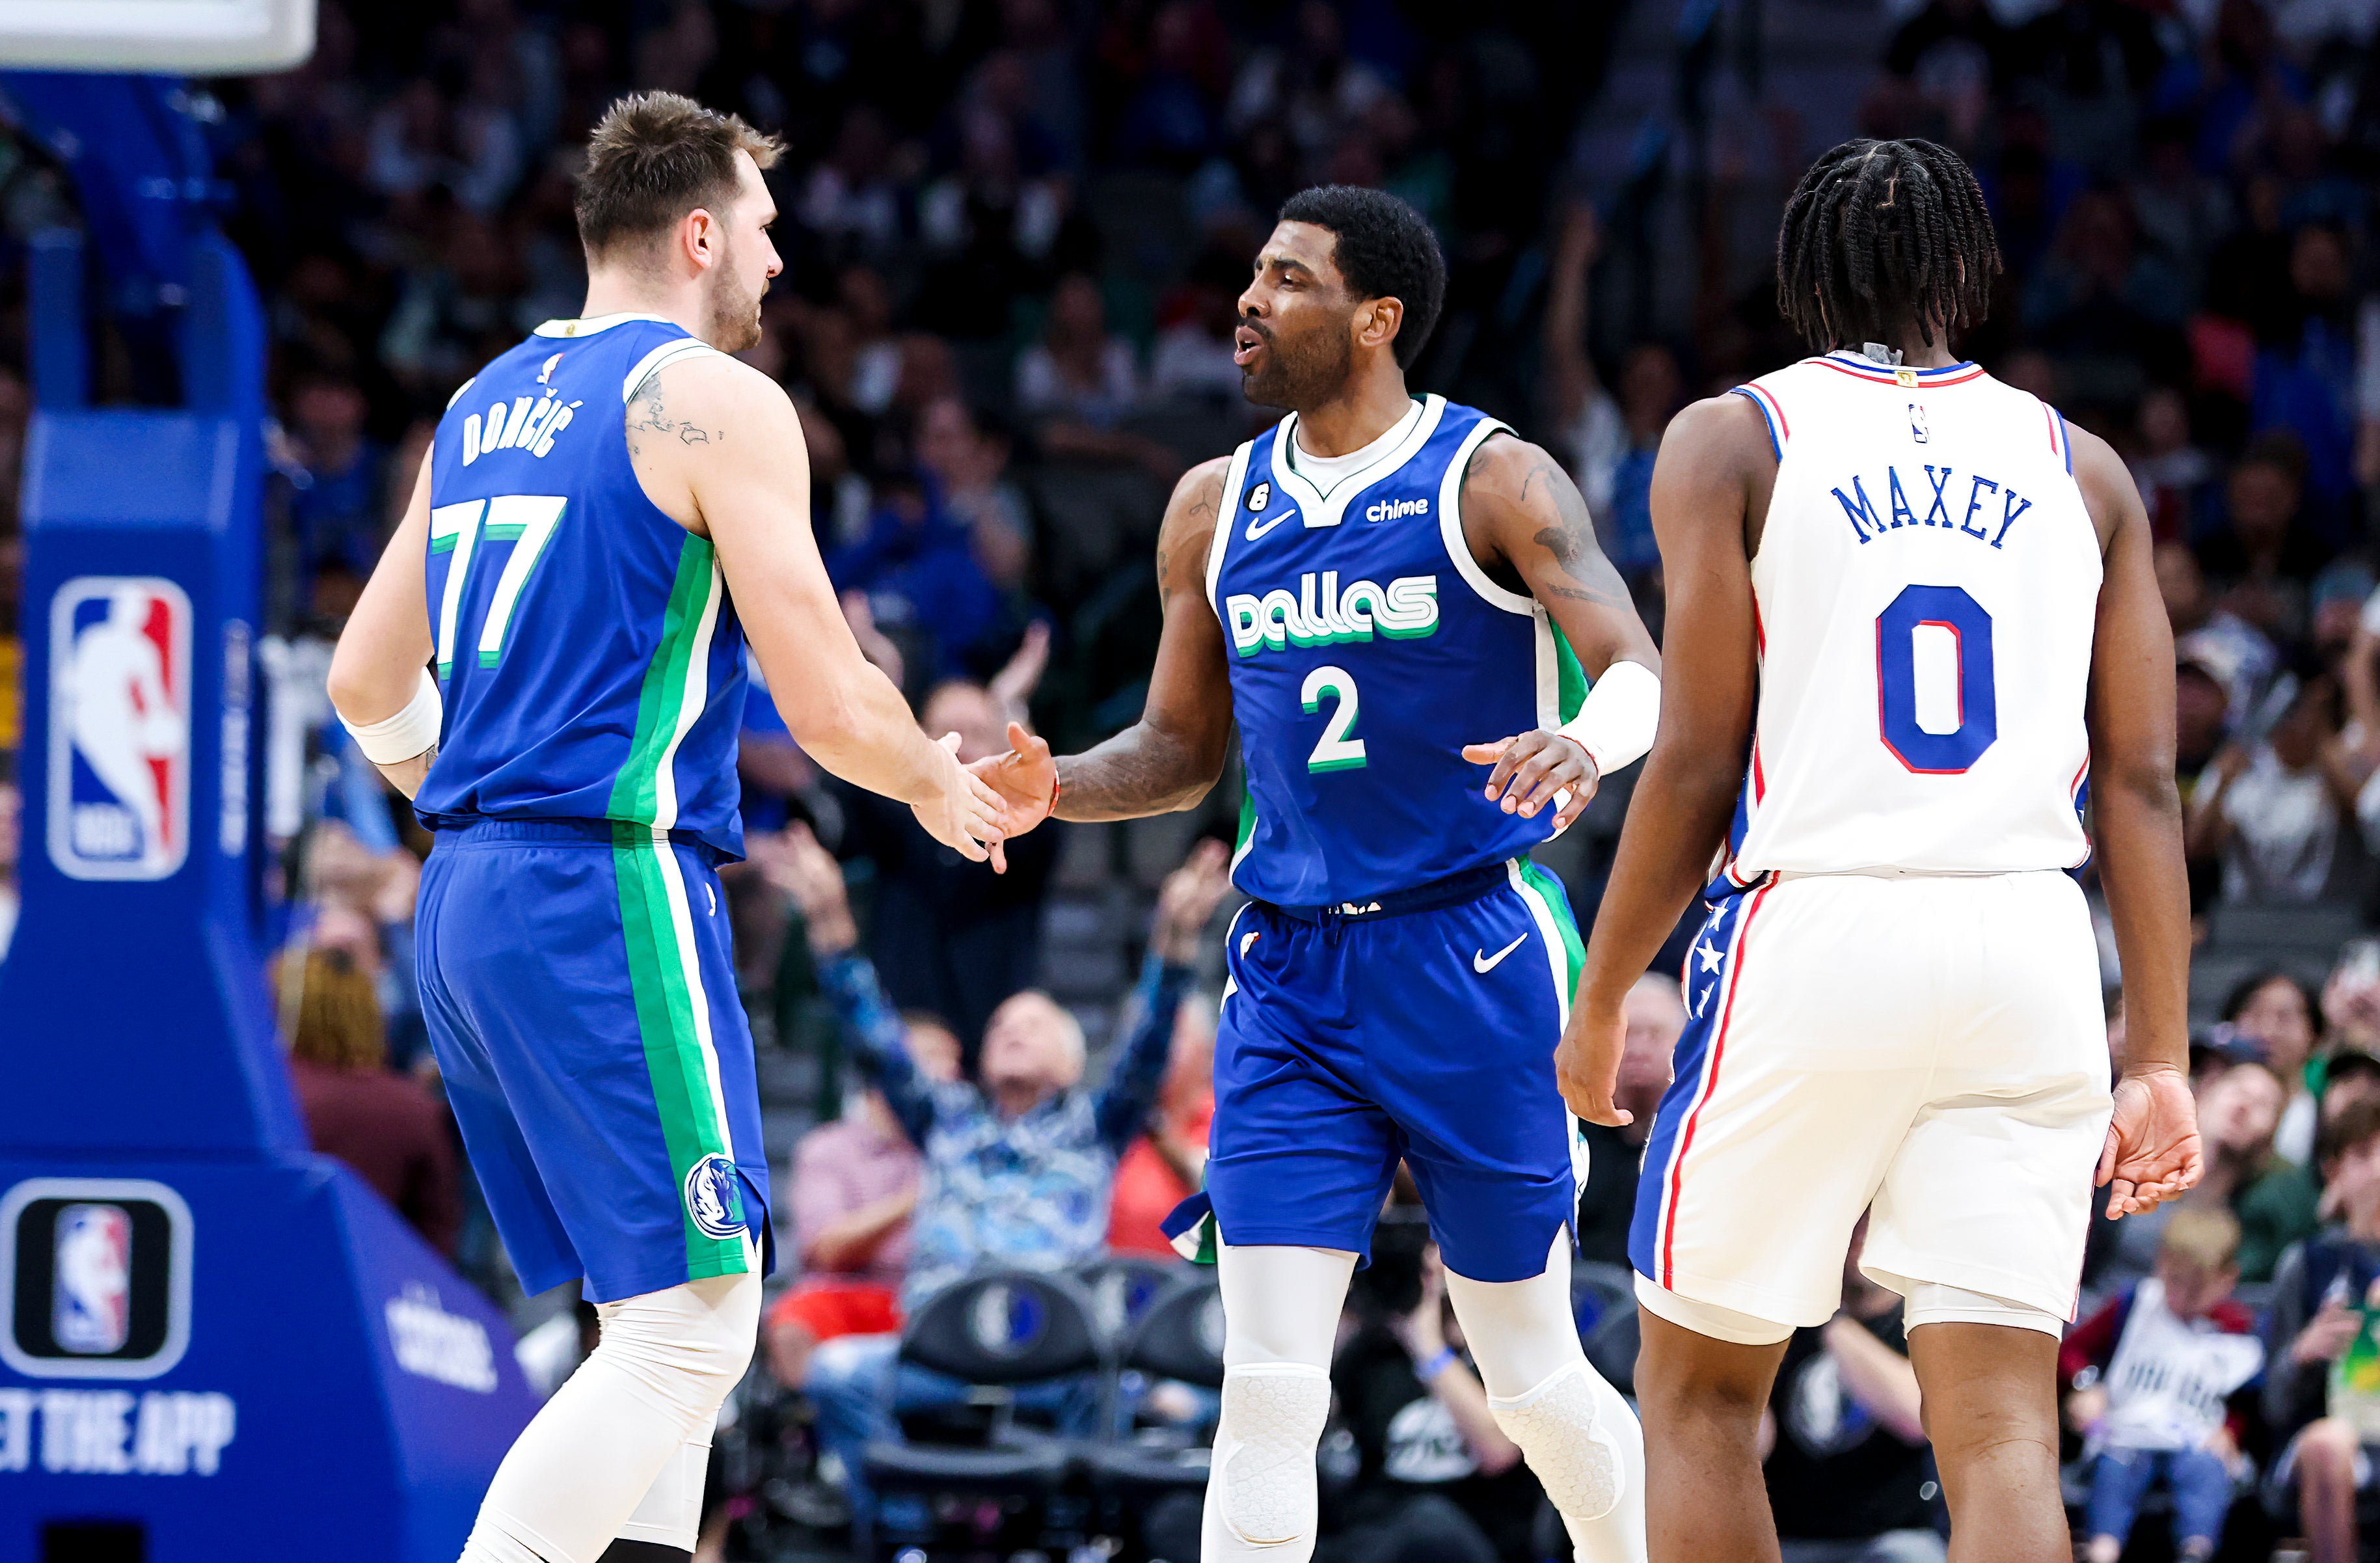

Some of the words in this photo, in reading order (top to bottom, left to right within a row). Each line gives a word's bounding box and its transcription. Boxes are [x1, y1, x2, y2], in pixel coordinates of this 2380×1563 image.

[464, 388, 583, 467] DONČIĆ
[1249, 483, 1269, 511] 6
[1366, 498, 1428, 522] chime
[1831, 465, 2032, 549] MAXEY
[431, 495, 567, 680] 77
[1301, 666, 1366, 774] 2
[1876, 584, 1997, 774] 0
[40, 1388, 135, 1474] THE
[135, 1391, 236, 1476] APP
